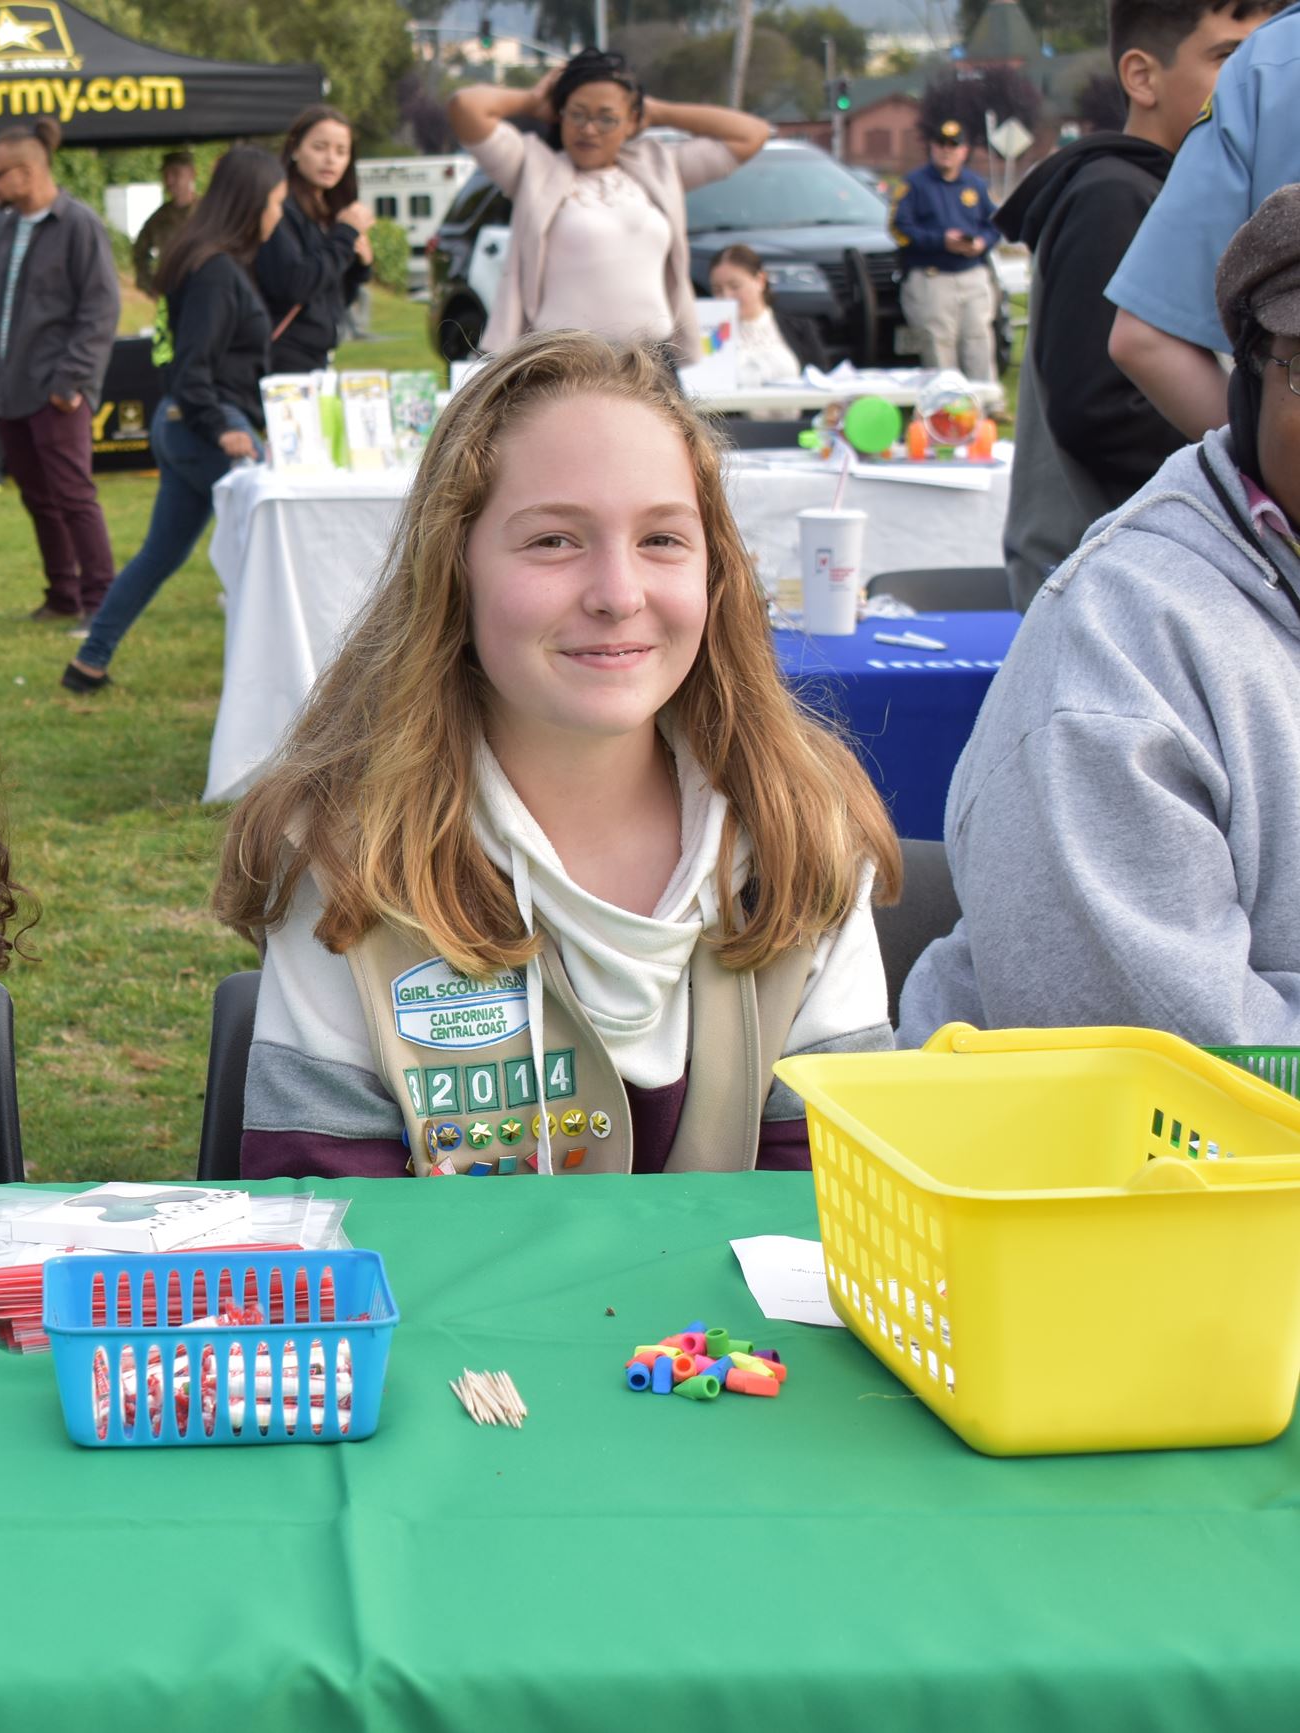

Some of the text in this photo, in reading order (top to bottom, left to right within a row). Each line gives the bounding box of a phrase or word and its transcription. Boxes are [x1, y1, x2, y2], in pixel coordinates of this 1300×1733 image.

[400, 984, 435, 1001] GIRL
[430, 1005, 504, 1026] CALIFORNIA'S
[430, 1020, 508, 1040] CENTRAL COAST
